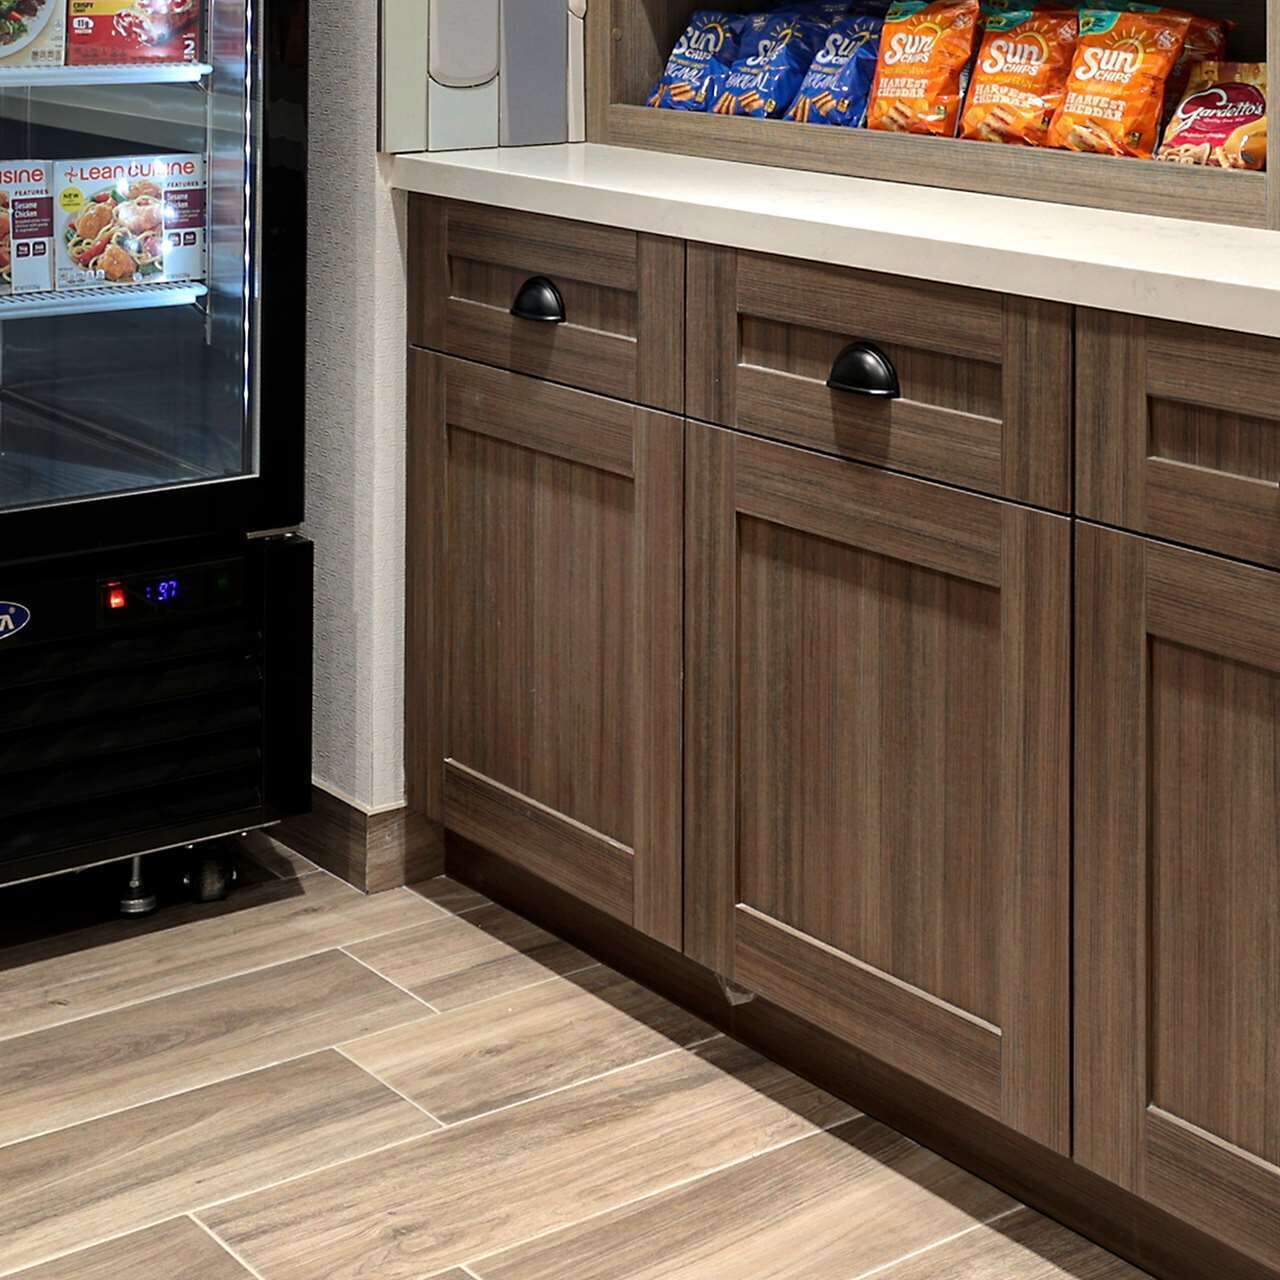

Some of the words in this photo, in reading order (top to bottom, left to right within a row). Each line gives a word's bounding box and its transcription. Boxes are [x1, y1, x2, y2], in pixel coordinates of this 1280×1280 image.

[184, 39, 195, 54] 2
[672, 26, 720, 54] Sun
[685, 50, 712, 60] CHIPS
[884, 32, 935, 65] Sun
[900, 52, 929, 64] CHIPS
[982, 39, 1041, 74] Sun
[1075, 47, 1137, 81] Sun
[1002, 64, 1039, 75] CHIPS
[879, 78, 928, 89] HARVEST
[1094, 71, 1132, 84] CHIPS
[877, 87, 926, 98] CHEDDAR
[1067, 93, 1126, 109] HARVEST
[1064, 103, 1124, 121] CHEDDAR
[1173, 88, 1264, 132] Gardetto's
[14, 188, 49, 196] FEATURES
